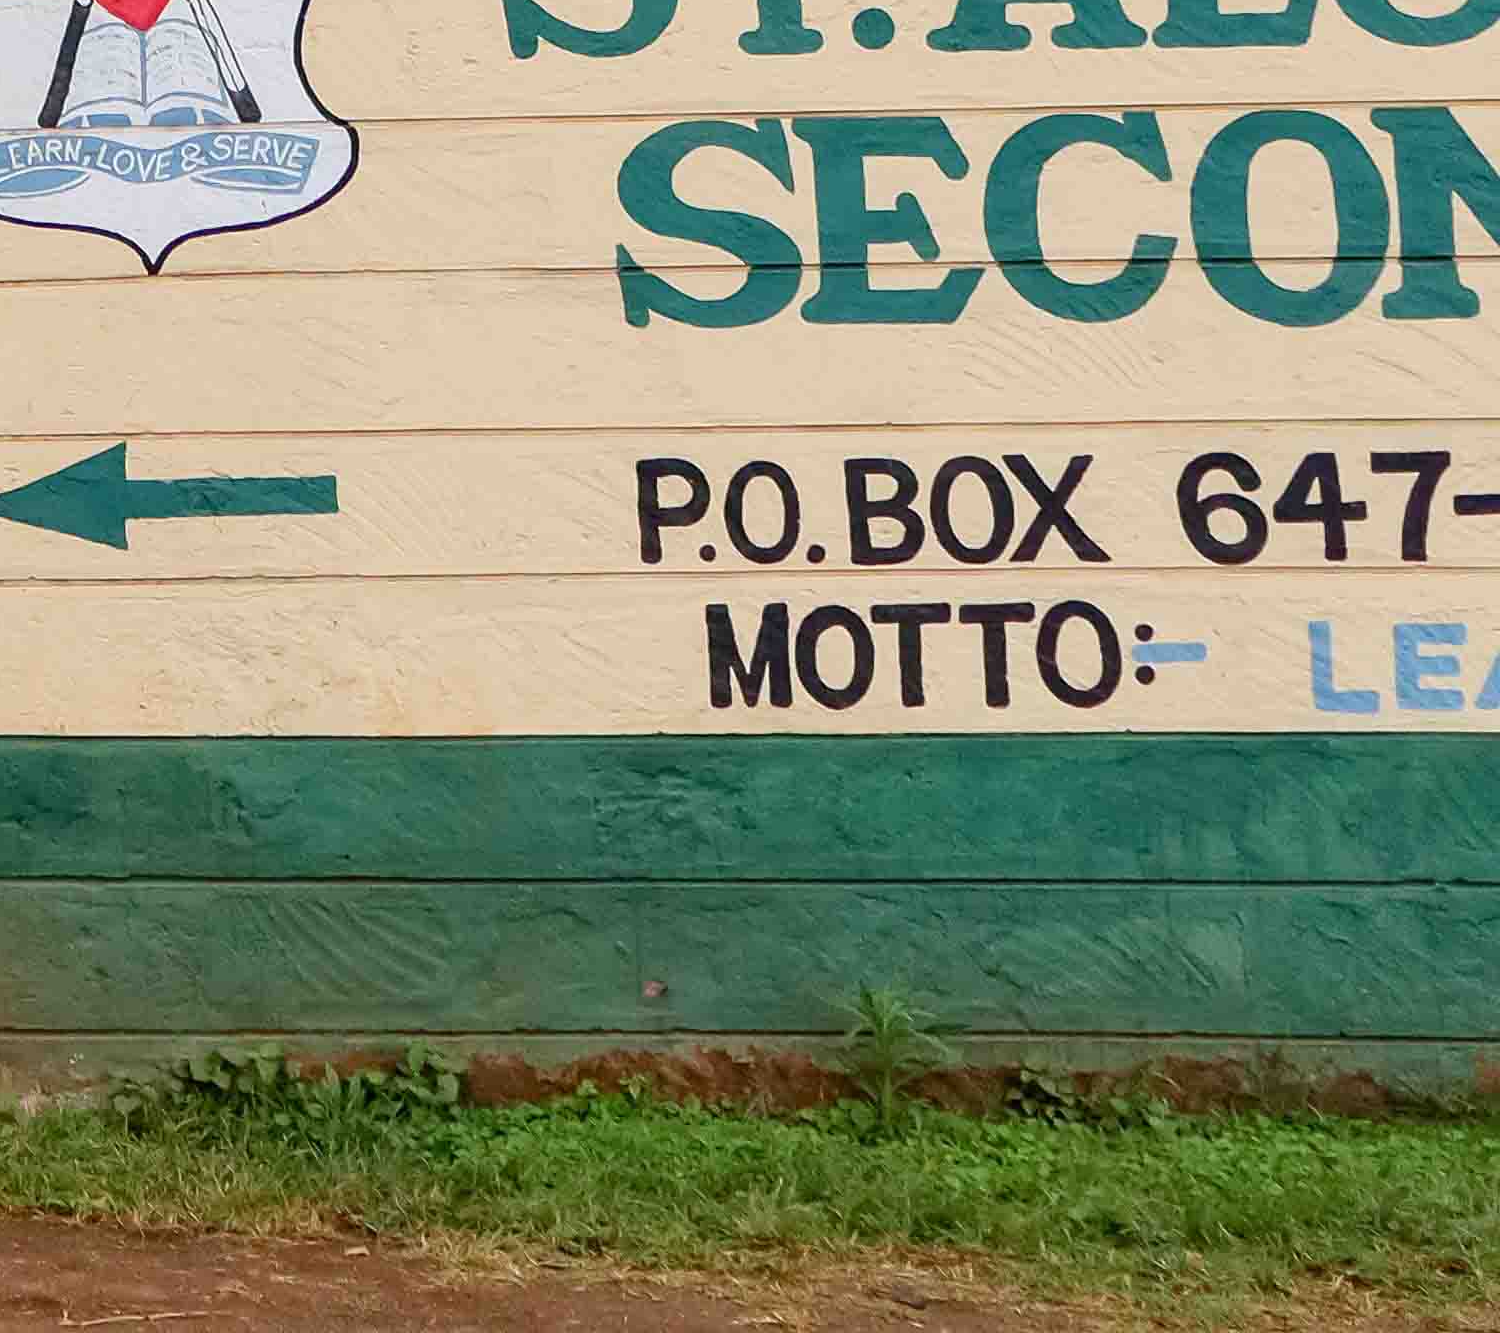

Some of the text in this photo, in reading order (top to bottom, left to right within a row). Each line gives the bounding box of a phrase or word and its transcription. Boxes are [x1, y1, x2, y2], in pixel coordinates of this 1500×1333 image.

[97, 148, 171, 182] LOVE
[181, 142, 208, 172] &
[211, 134, 316, 170] SERVE
[1176, 450, 1500, 566] 647-
